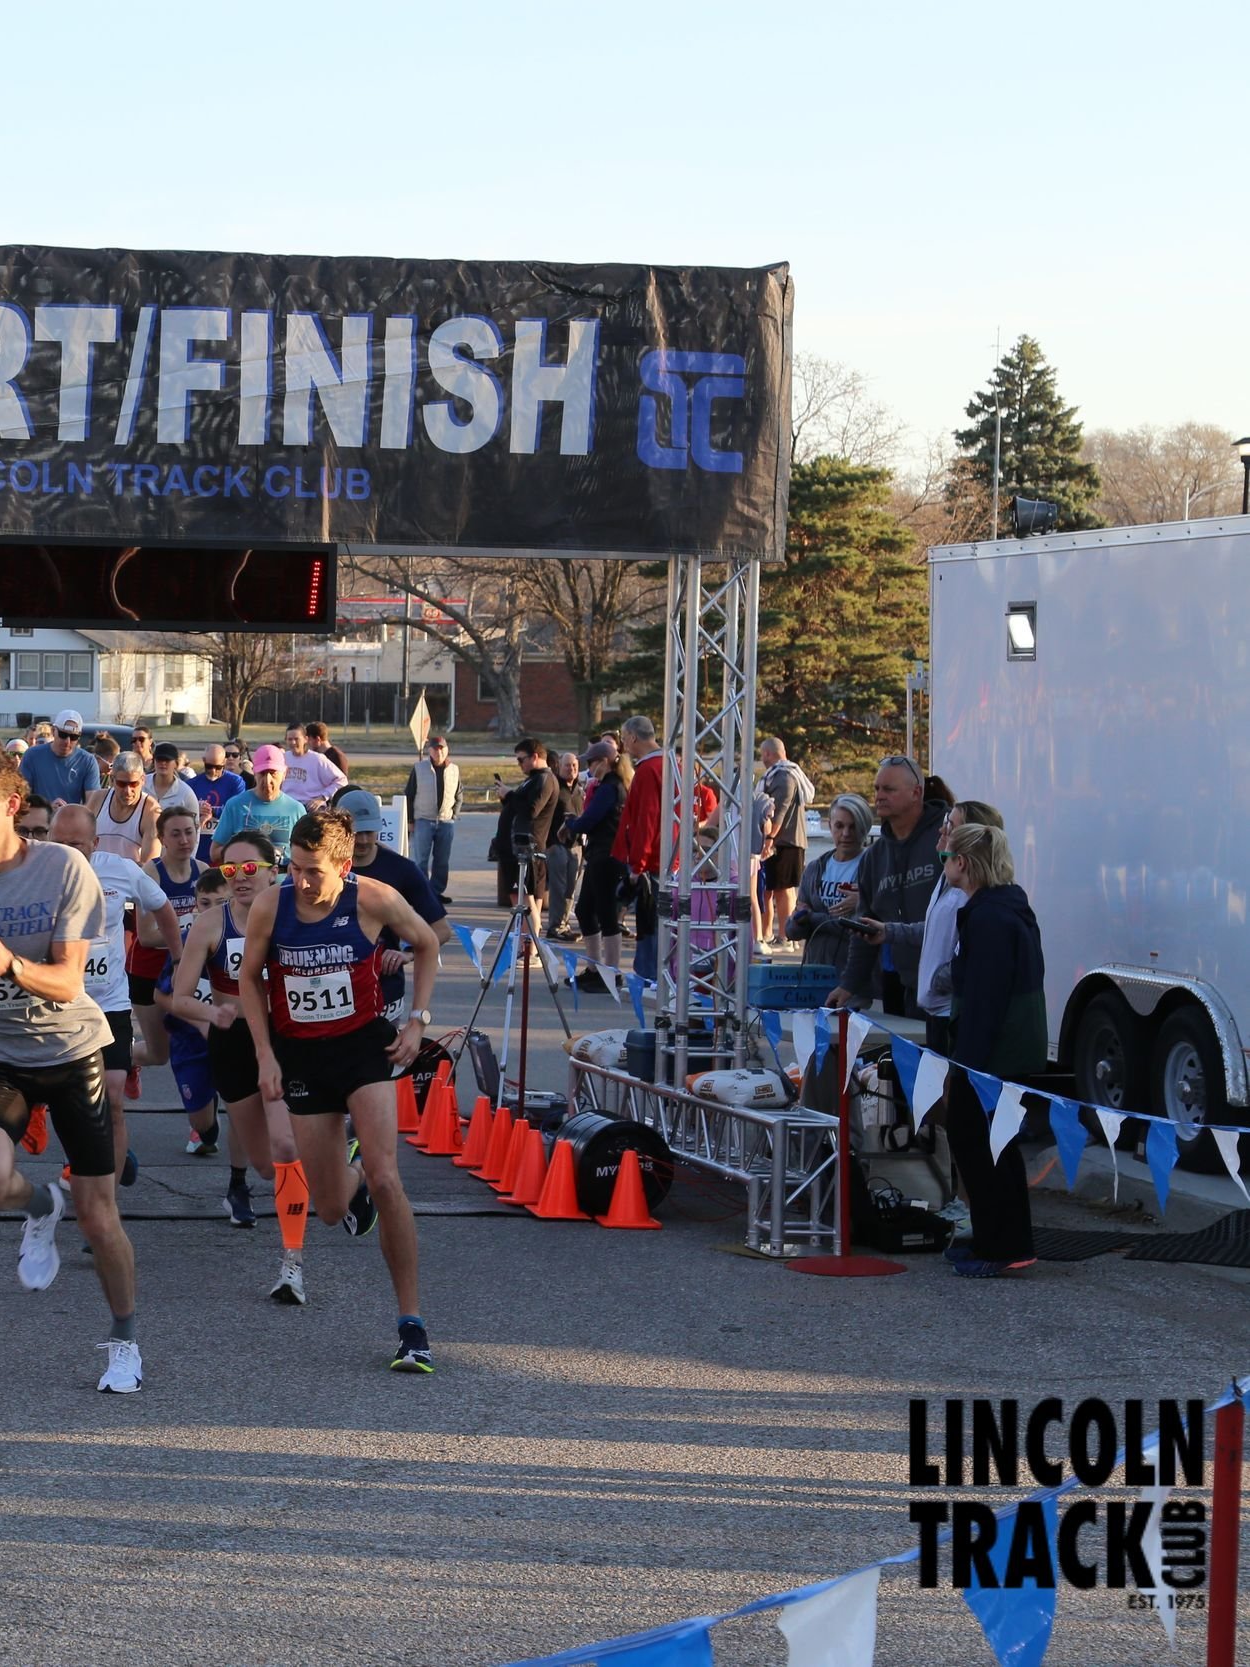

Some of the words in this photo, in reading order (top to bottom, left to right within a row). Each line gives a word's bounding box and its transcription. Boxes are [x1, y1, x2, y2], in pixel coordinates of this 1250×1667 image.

[107, 462, 250, 499] TRACK
[264, 464, 372, 500] CLUB
[85, 956, 108, 976] 46
[287, 985, 352, 1012] 9511
[336, 1009, 352, 1017] Club
